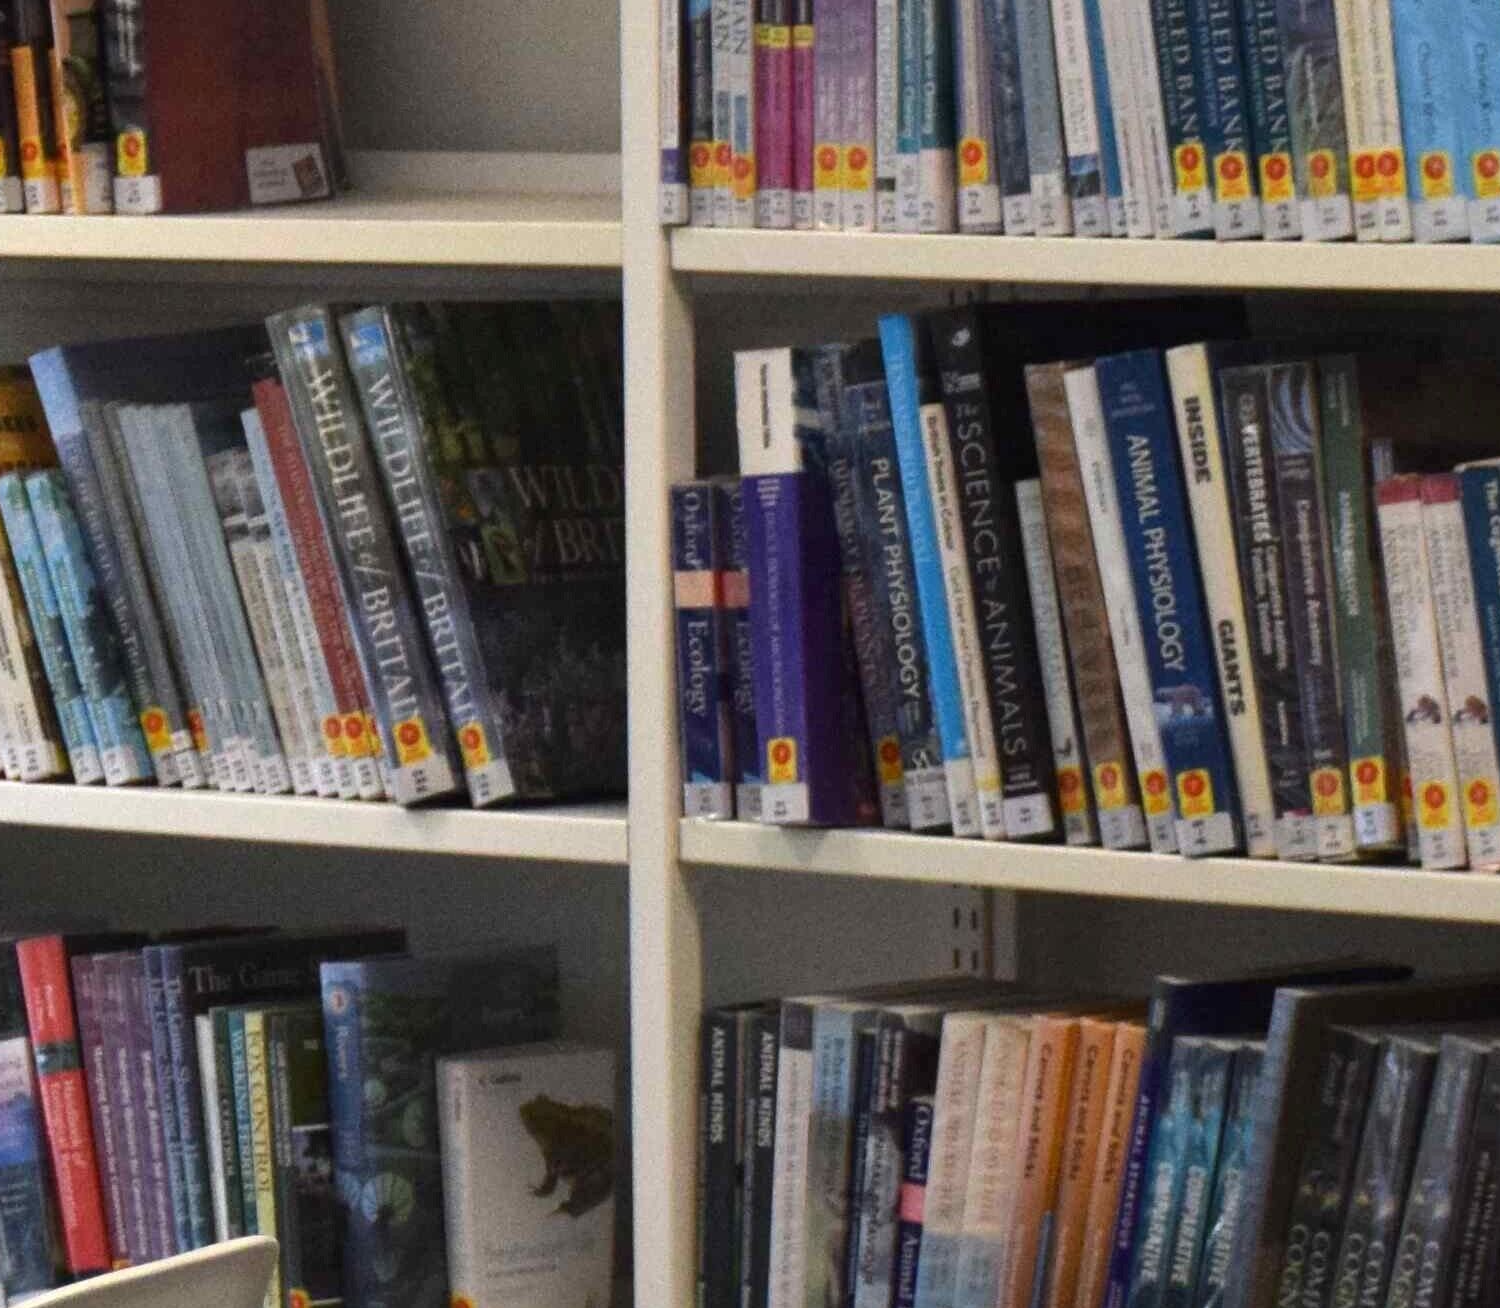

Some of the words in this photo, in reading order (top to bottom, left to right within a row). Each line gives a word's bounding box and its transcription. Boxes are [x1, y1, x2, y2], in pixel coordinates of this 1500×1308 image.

[304, 367, 377, 548] WILDLIFE
[364, 372, 435, 557] WILDLIFE
[1127, 434, 1161, 524] ANIMAL
[1241, 423, 1272, 543] VERTEBRATES
[1481, 478, 1500, 512] The
[872, 457, 900, 540] PLANT
[886, 544, 921, 699] PHYSIOLOGY
[956, 423, 1001, 574] SCIENCE
[982, 604, 1028, 757] ANIMALS
[1184, 396, 1212, 485] INSIDE
[1217, 617, 1246, 717] GIANTS
[1293, 499, 1318, 597] Comparative
[1140, 526, 1187, 672] PHYSIOLOGY
[686, 620, 710, 719] Ecology
[191, 961, 234, 994] The
[229, 1028, 250, 1120] WORKING
[245, 1027, 264, 1074] FOX
[709, 1026, 726, 1088] ANIMAL
[757, 1031, 775, 1091] ANIMAL
[249, 1082, 273, 1196] CONTROL
[708, 1092, 724, 1144] MINDS
[755, 1096, 773, 1148] MINDS
[907, 1103, 934, 1180] Oxford
[896, 1231, 922, 1300] Animal
[1169, 1163, 1208, 1288] COMPARATIVE
